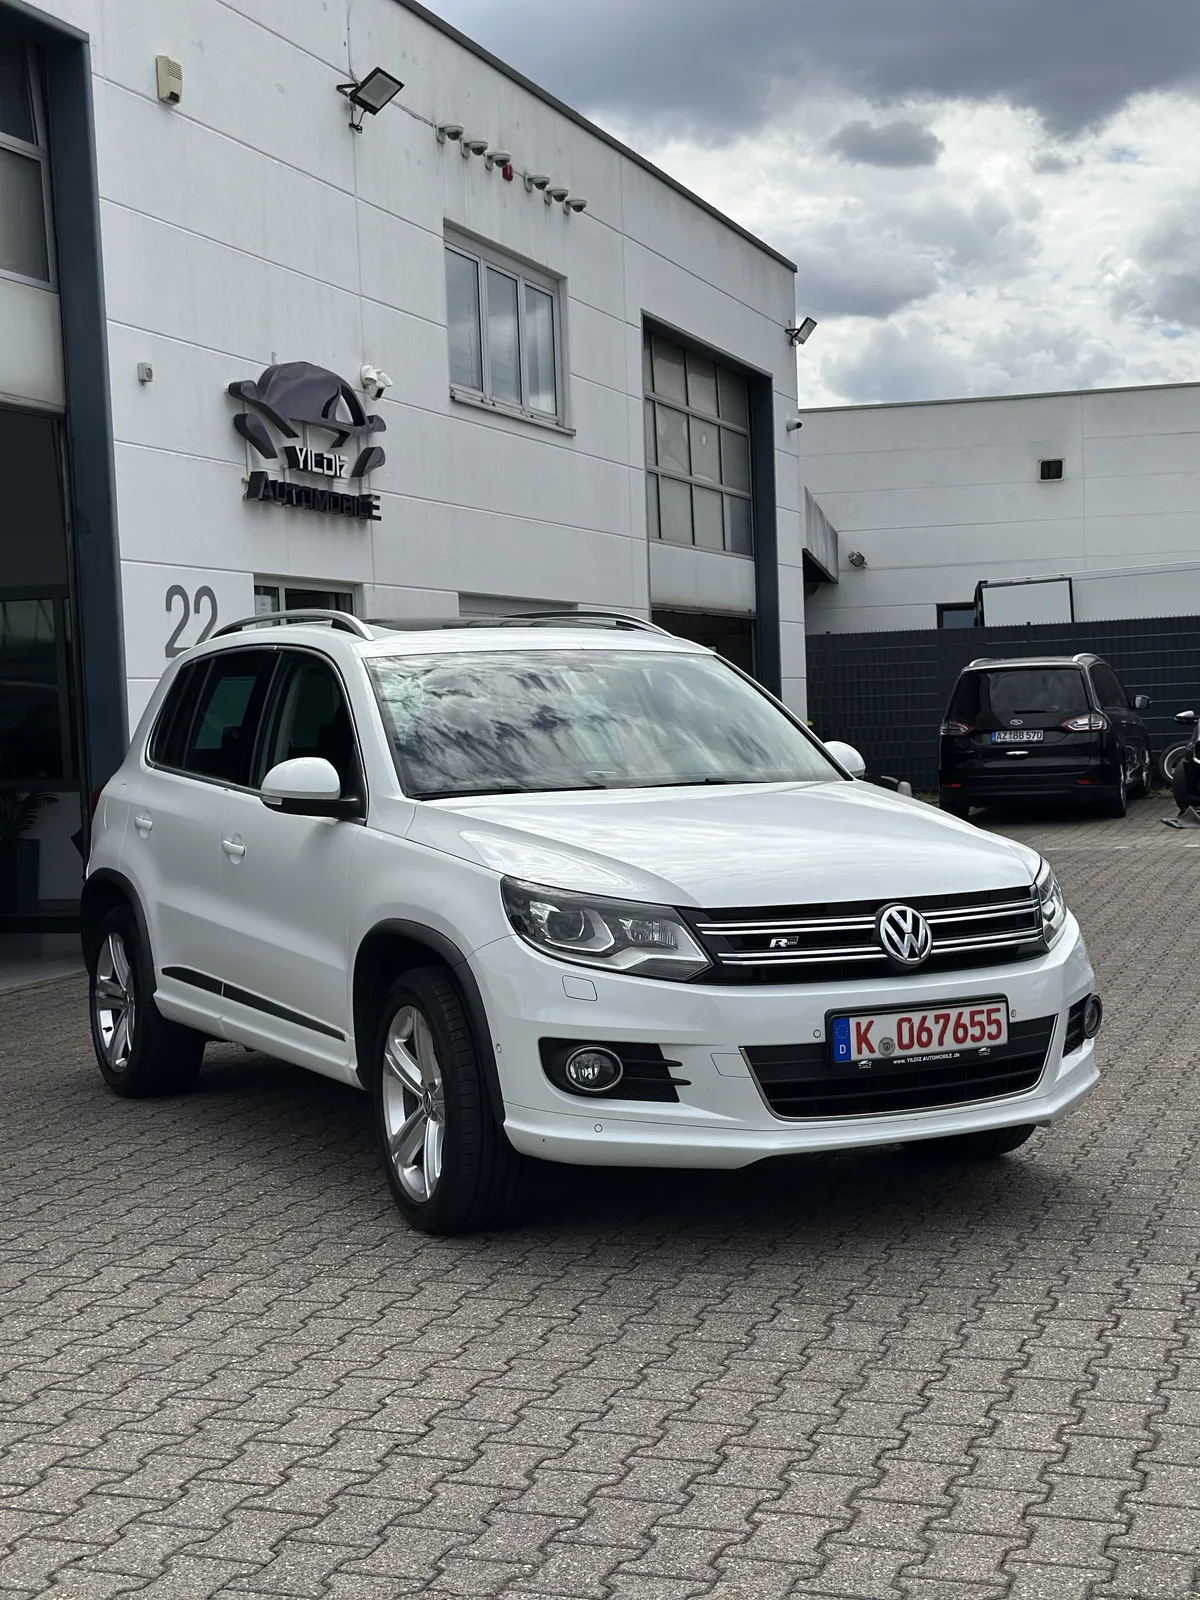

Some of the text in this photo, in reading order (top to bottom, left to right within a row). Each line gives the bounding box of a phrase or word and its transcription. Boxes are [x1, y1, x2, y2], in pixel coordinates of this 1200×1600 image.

[292, 446, 349, 479] YILDIZ
[248, 471, 382, 521] AUTOMOBILE
[165, 585, 217, 658] 22
[996, 731, 1042, 741] AZ BB 570
[855, 1007, 1003, 1055] K 067655
[839, 1045, 846, 1055] D
[906, 1055, 922, 1063] YILDIZ
[922, 1053, 952, 1061] AUTOMOBILE
